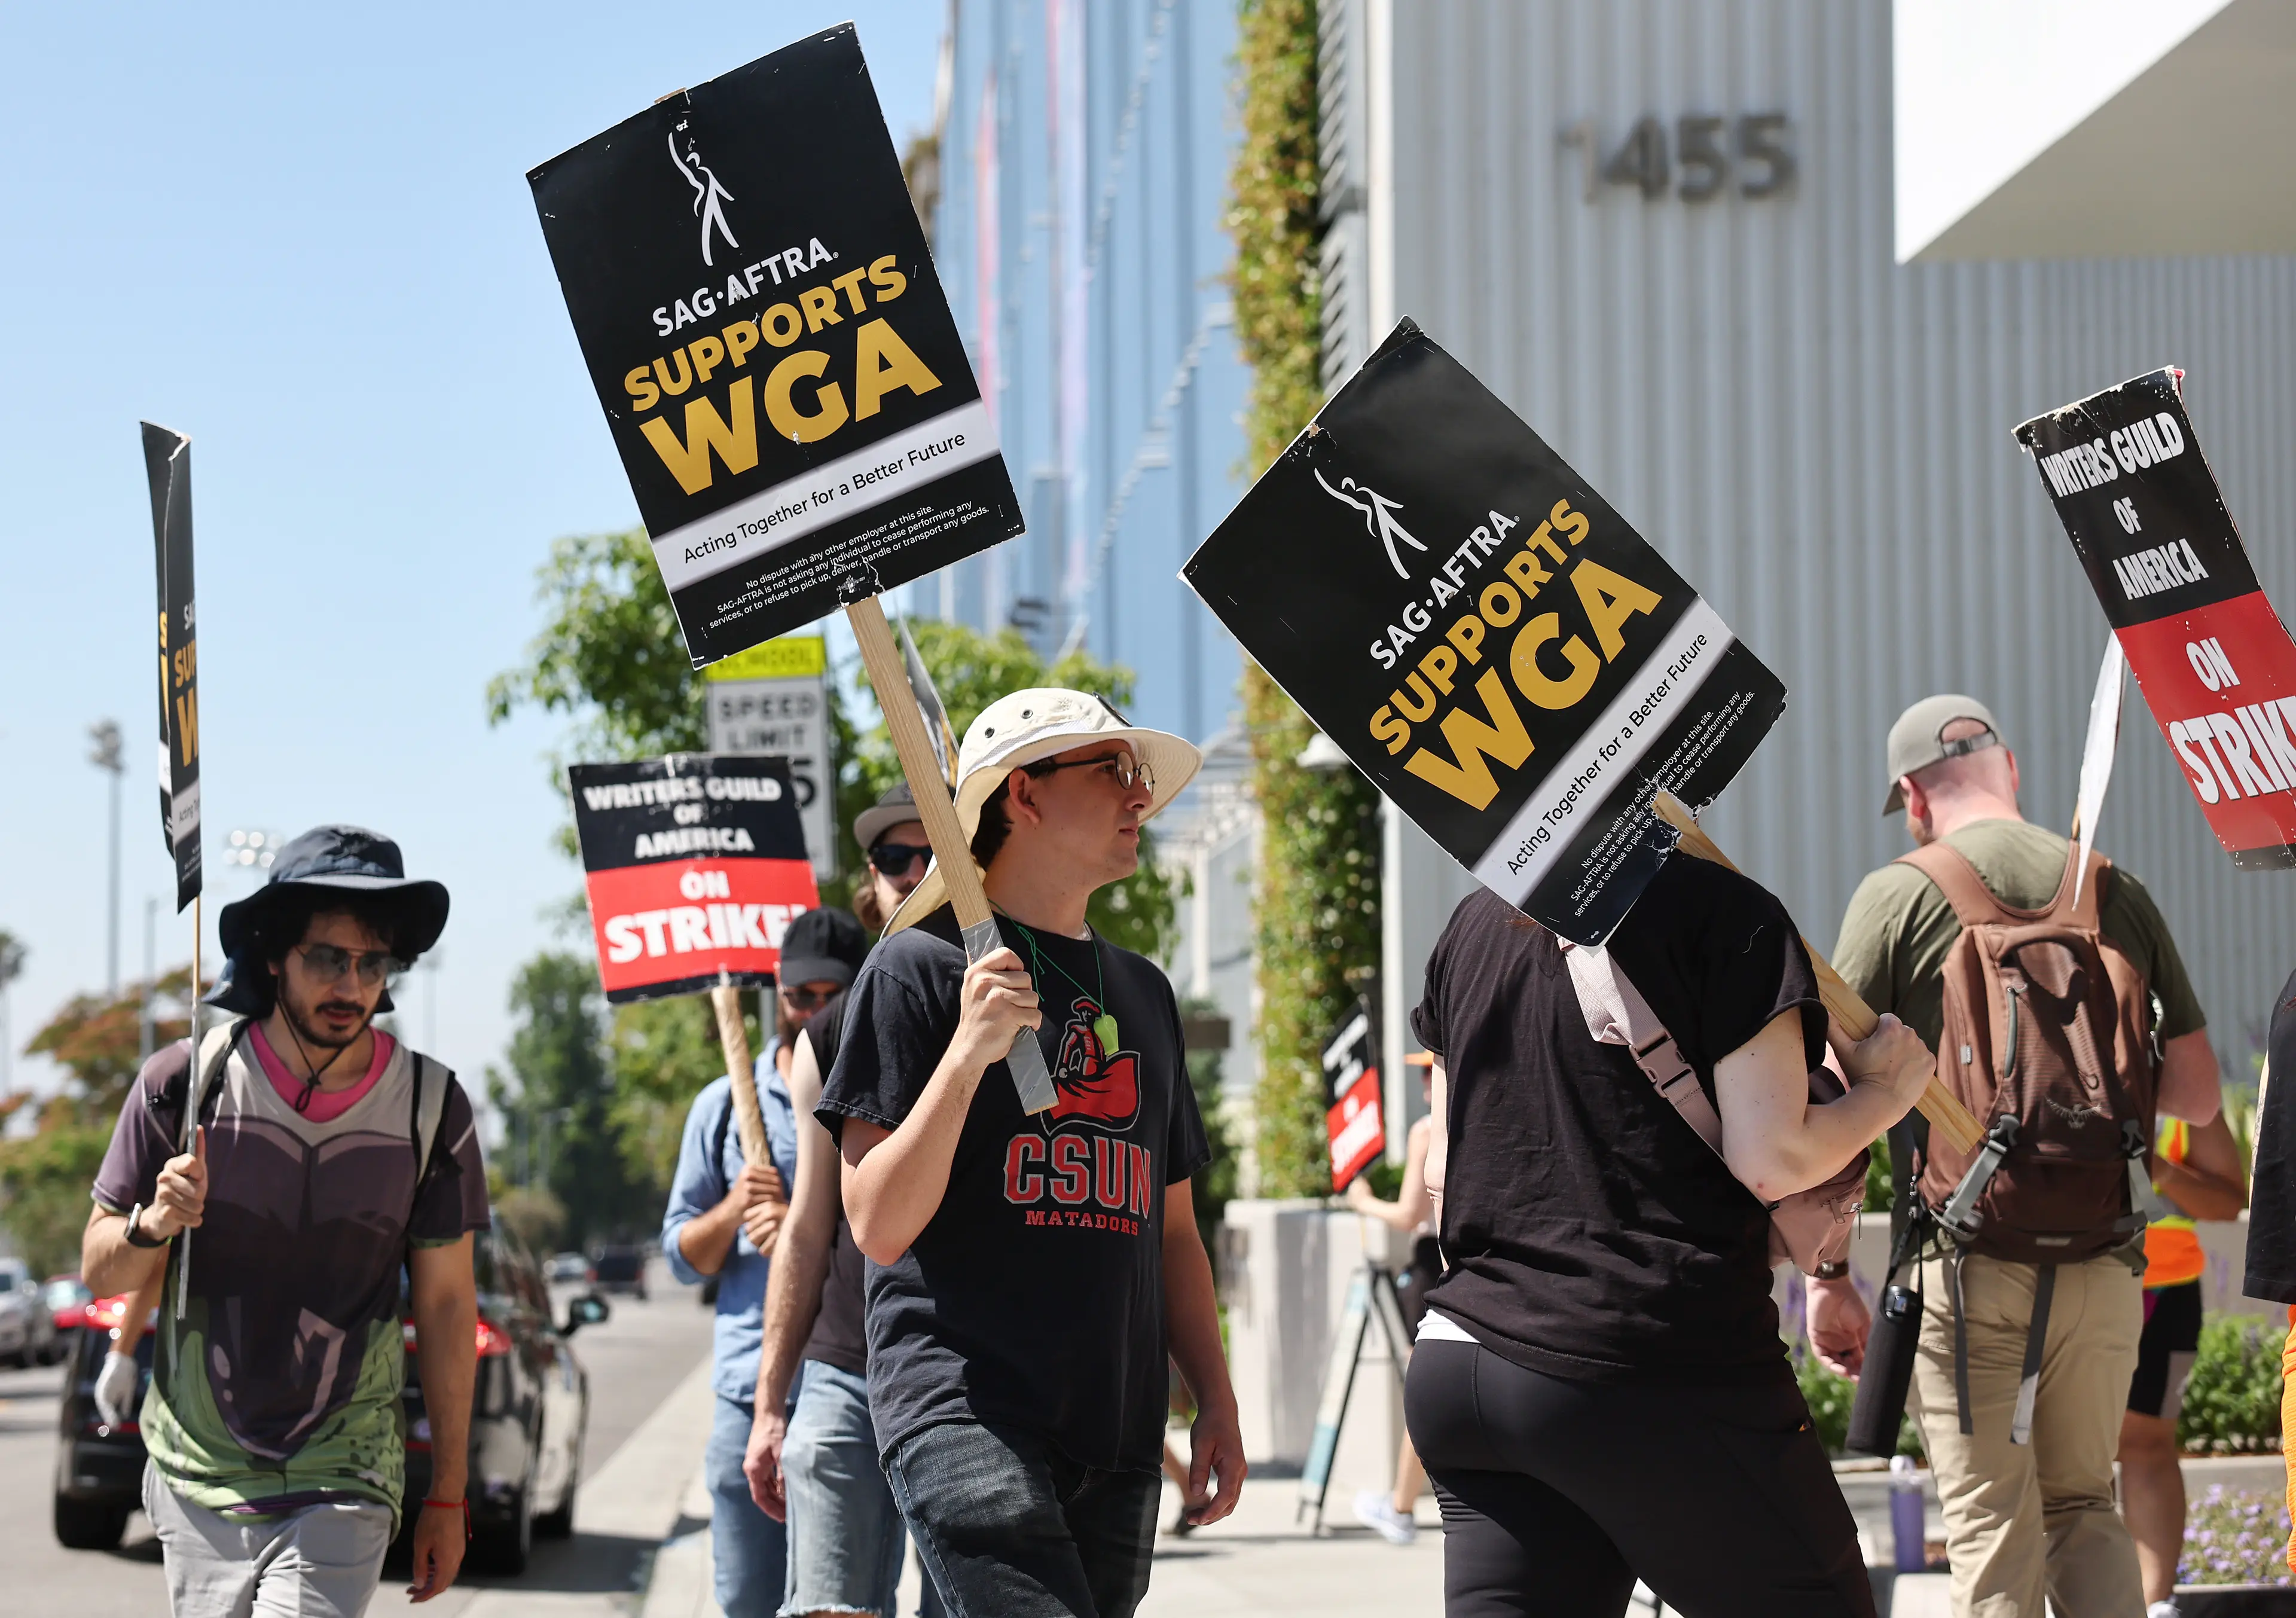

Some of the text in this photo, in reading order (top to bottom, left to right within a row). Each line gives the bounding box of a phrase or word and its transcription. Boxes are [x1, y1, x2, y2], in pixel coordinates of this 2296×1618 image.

[1557, 114, 1797, 204] 1455
[624, 255, 906, 411] SUPPORTS
[639, 318, 942, 495] WGA
[2040, 412, 2185, 497] WRITERS GUILD
[685, 434, 964, 563] Acting Together for a Better Future
[2112, 497, 2142, 535] OF
[709, 610, 743, 628] services,
[764, 590, 789, 605] refuse
[800, 577, 817, 591] pick
[818, 573, 831, 582] up,
[831, 560, 862, 576] deliver,
[862, 547, 891, 565] handle
[902, 525, 942, 546] transport
[943, 518, 958, 529] any
[960, 506, 989, 524] goods.
[717, 588, 764, 613] SAG-AFTRA
[773, 579, 787, 590] not
[787, 567, 814, 583] asking
[814, 561, 828, 572] any
[829, 542, 871, 565] individual
[883, 529, 906, 542] cease
[907, 508, 955, 534] performing
[956, 500, 971, 512] any
[746, 506, 933, 589] No dispute with any other employer at this site.
[2112, 538, 2209, 600] AMERICA
[1370, 499, 1589, 756] SUPPORTS
[2186, 637, 2241, 692] ON
[719, 694, 817, 721] SPEED
[1403, 558, 1662, 811] WGA
[727, 726, 805, 750] LIMIT
[1507, 634, 1706, 875] Acting Together for a Better Future
[584, 777, 782, 811] WRITERS GUILD
[674, 804, 703, 825] OF
[1571, 863, 1604, 900] SAG-AFTRA
[1605, 844, 1618, 857] not
[1615, 822, 1636, 845] asking
[1632, 808, 1645, 823] any
[1673, 764, 1683, 773] to
[1682, 743, 1700, 764] cease
[1699, 704, 1731, 745] performing
[1729, 691, 1740, 706] any
[1574, 889, 1600, 917] services,
[1596, 880, 1604, 888] or
[1608, 852, 1626, 872] refuse
[1630, 829, 1644, 845] pick
[1641, 818, 1654, 828] up,
[1671, 767, 1695, 793] handle
[1694, 757, 1702, 767] or
[1701, 725, 1729, 758] transport
[1727, 712, 1738, 726] any
[1736, 691, 1754, 715] goods.
[1581, 712, 1713, 868] No dispute with any other employer at this site.
[634, 828, 755, 859] AMERICA
[680, 871, 731, 900] ON
[1003, 1134, 1151, 1219] CSUN
[1025, 1210, 1138, 1236] MATADORS
